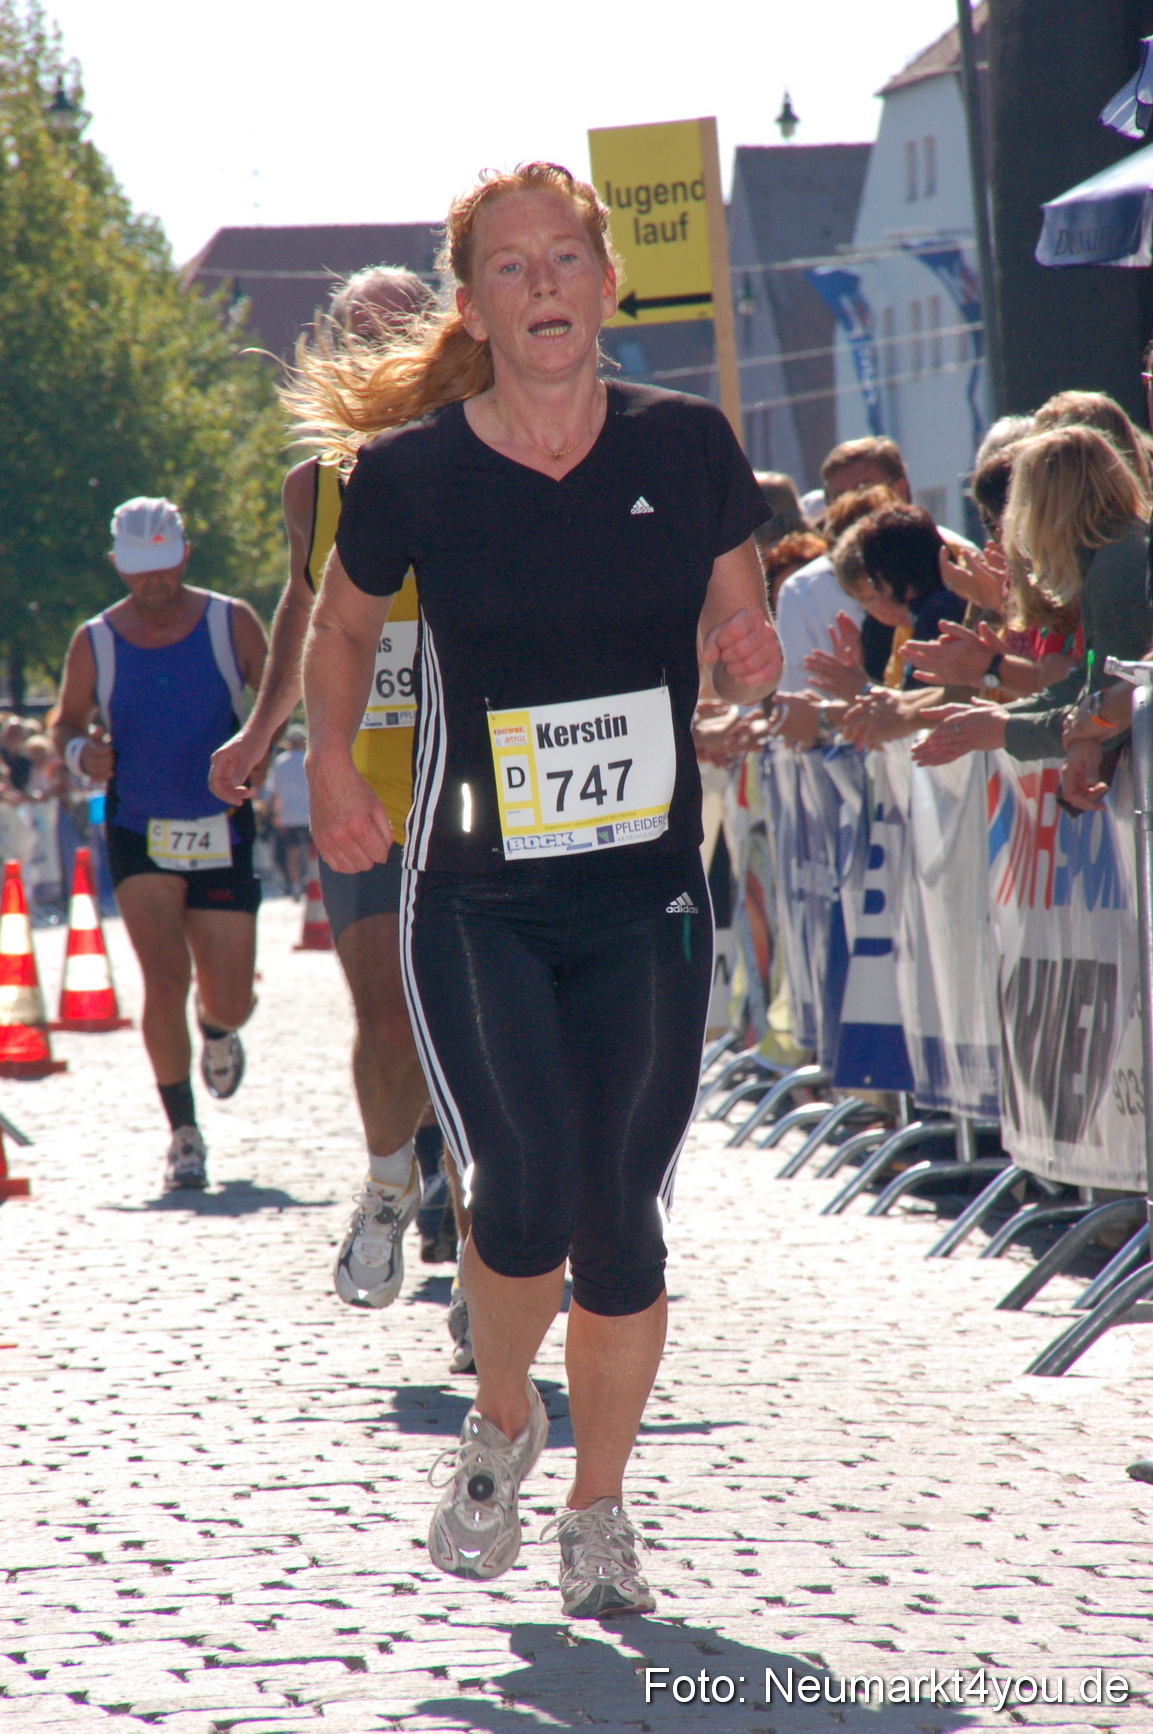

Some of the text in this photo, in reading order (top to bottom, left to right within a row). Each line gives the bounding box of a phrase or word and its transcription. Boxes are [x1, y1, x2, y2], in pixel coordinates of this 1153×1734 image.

[634, 211, 690, 246] lauf
[536, 713, 628, 749] Kerstin
[506, 766, 526, 789] D
[546, 758, 633, 813] 747
[170, 831, 210, 851] 774
[507, 831, 574, 851] BOCK
[665, 904, 699, 914] adidas
